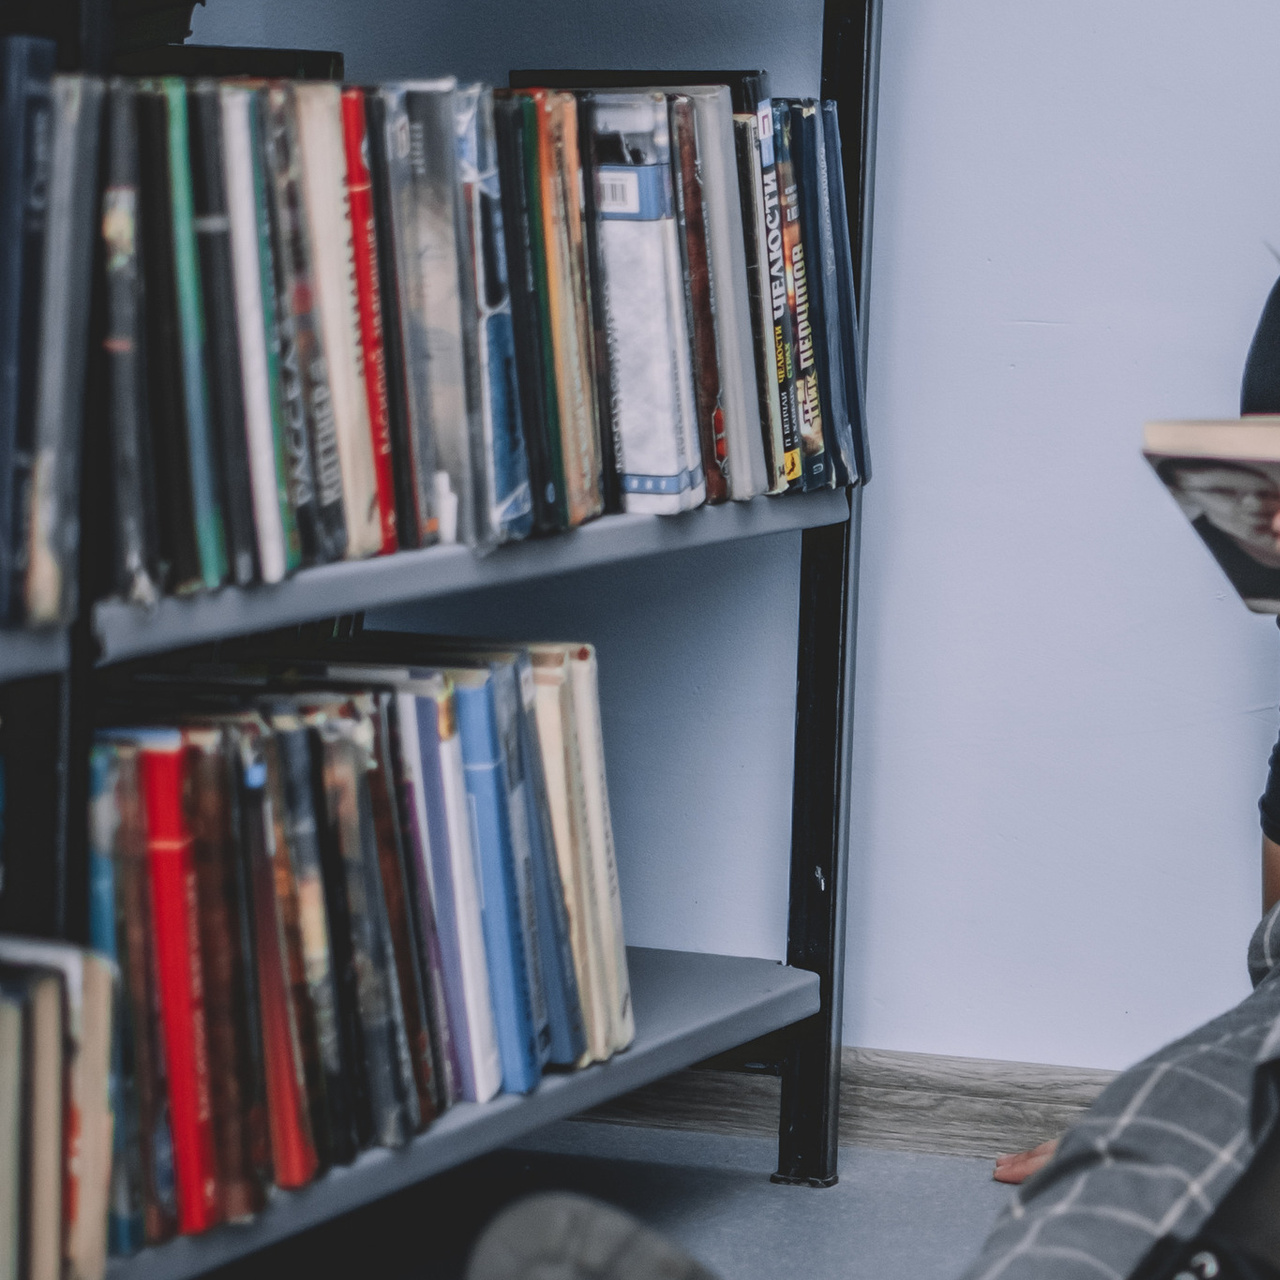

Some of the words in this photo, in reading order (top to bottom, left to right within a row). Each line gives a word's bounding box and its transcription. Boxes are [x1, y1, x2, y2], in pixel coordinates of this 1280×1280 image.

[763, 169, 786, 320] ЧЕЛЮСТИ
[774, 324, 785, 383] ЧЕЛЮСТИ
[784, 342, 793, 379] СТРАХ
[781, 390, 789, 434] БЕНЧЛИ
